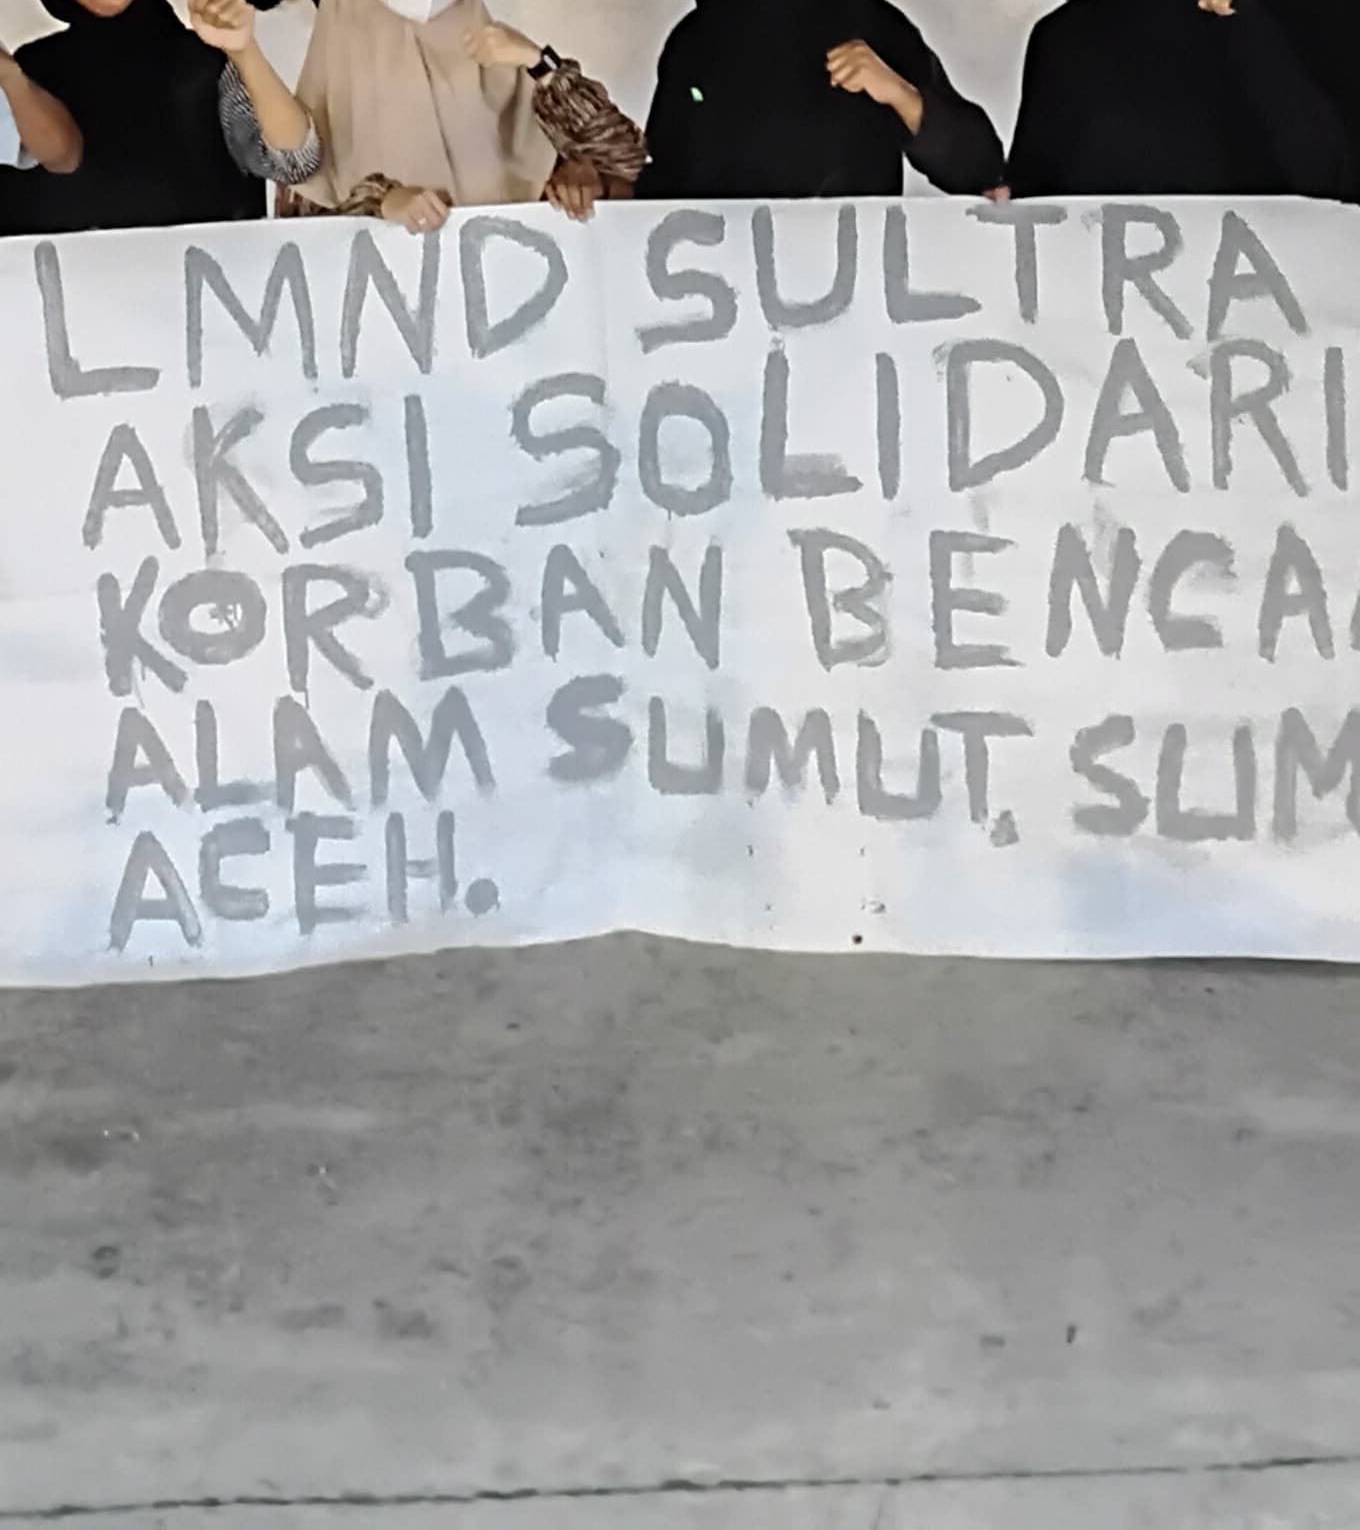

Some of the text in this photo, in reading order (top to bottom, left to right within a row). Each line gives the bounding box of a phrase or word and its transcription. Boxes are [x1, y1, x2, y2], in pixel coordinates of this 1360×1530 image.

[35, 205, 1307, 398] LMND SULTRA
[83, 394, 432, 554] AKSI
[97, 538, 720, 695] KORBAN
[107, 685, 495, 823] ALAM
[109, 810, 499, 951] ACEH.
